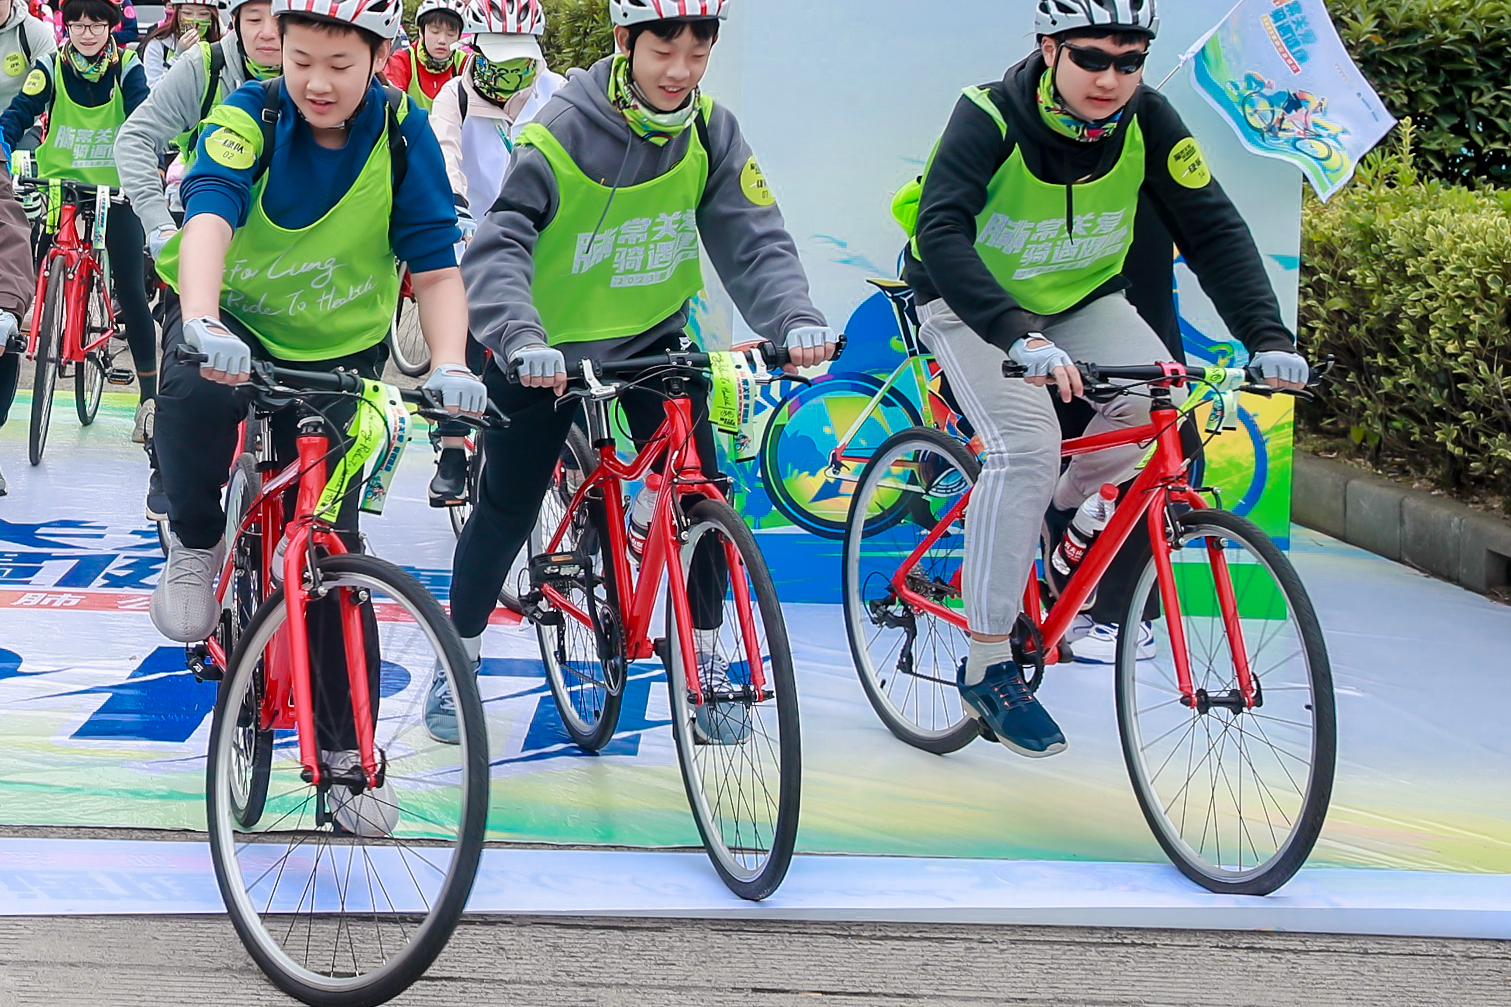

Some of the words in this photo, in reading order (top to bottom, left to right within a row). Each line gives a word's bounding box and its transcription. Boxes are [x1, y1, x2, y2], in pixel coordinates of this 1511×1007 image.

[53, 124, 121, 151] 肺常关
[222, 150, 235, 161] 02
[266, 243, 348, 289] Lung
[226, 287, 286, 316] Ride
[286, 289, 307, 317] To
[316, 274, 379, 312] Health
